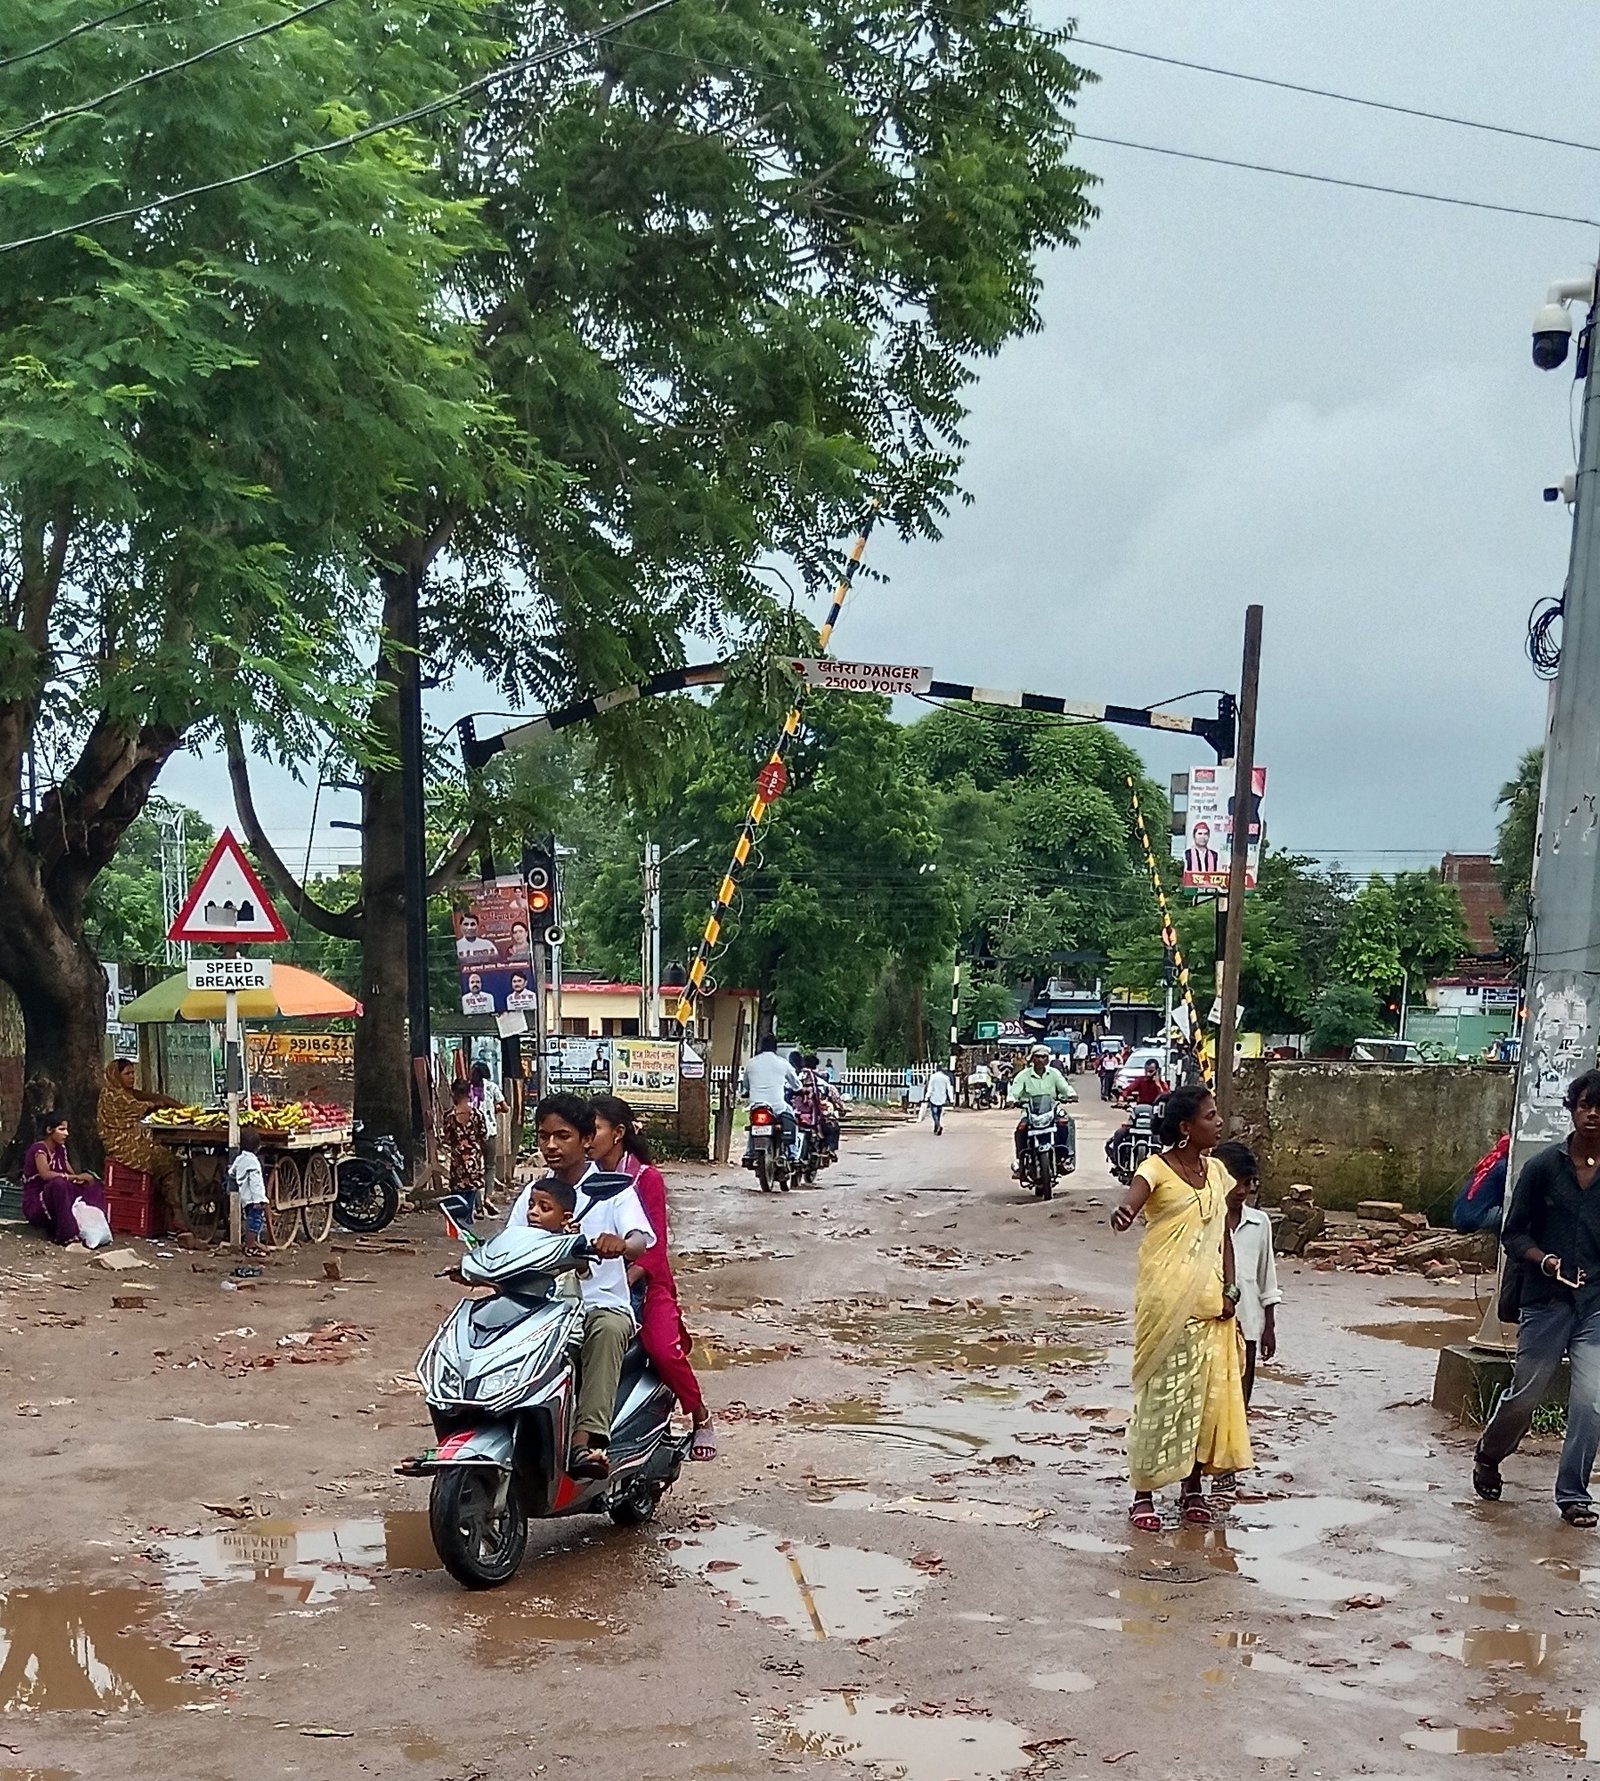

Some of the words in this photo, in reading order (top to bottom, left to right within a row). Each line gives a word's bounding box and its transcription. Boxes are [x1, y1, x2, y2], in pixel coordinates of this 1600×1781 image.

[817, 661, 858, 675] खतरा
[862, 665, 919, 680] DANGER
[825, 676, 865, 690] 25000
[871, 680, 912, 693] VOLTS
[767, 770, 779, 795] STOP
[206, 962, 253, 974] SPEED
[195, 975, 265, 987] BREAKER
